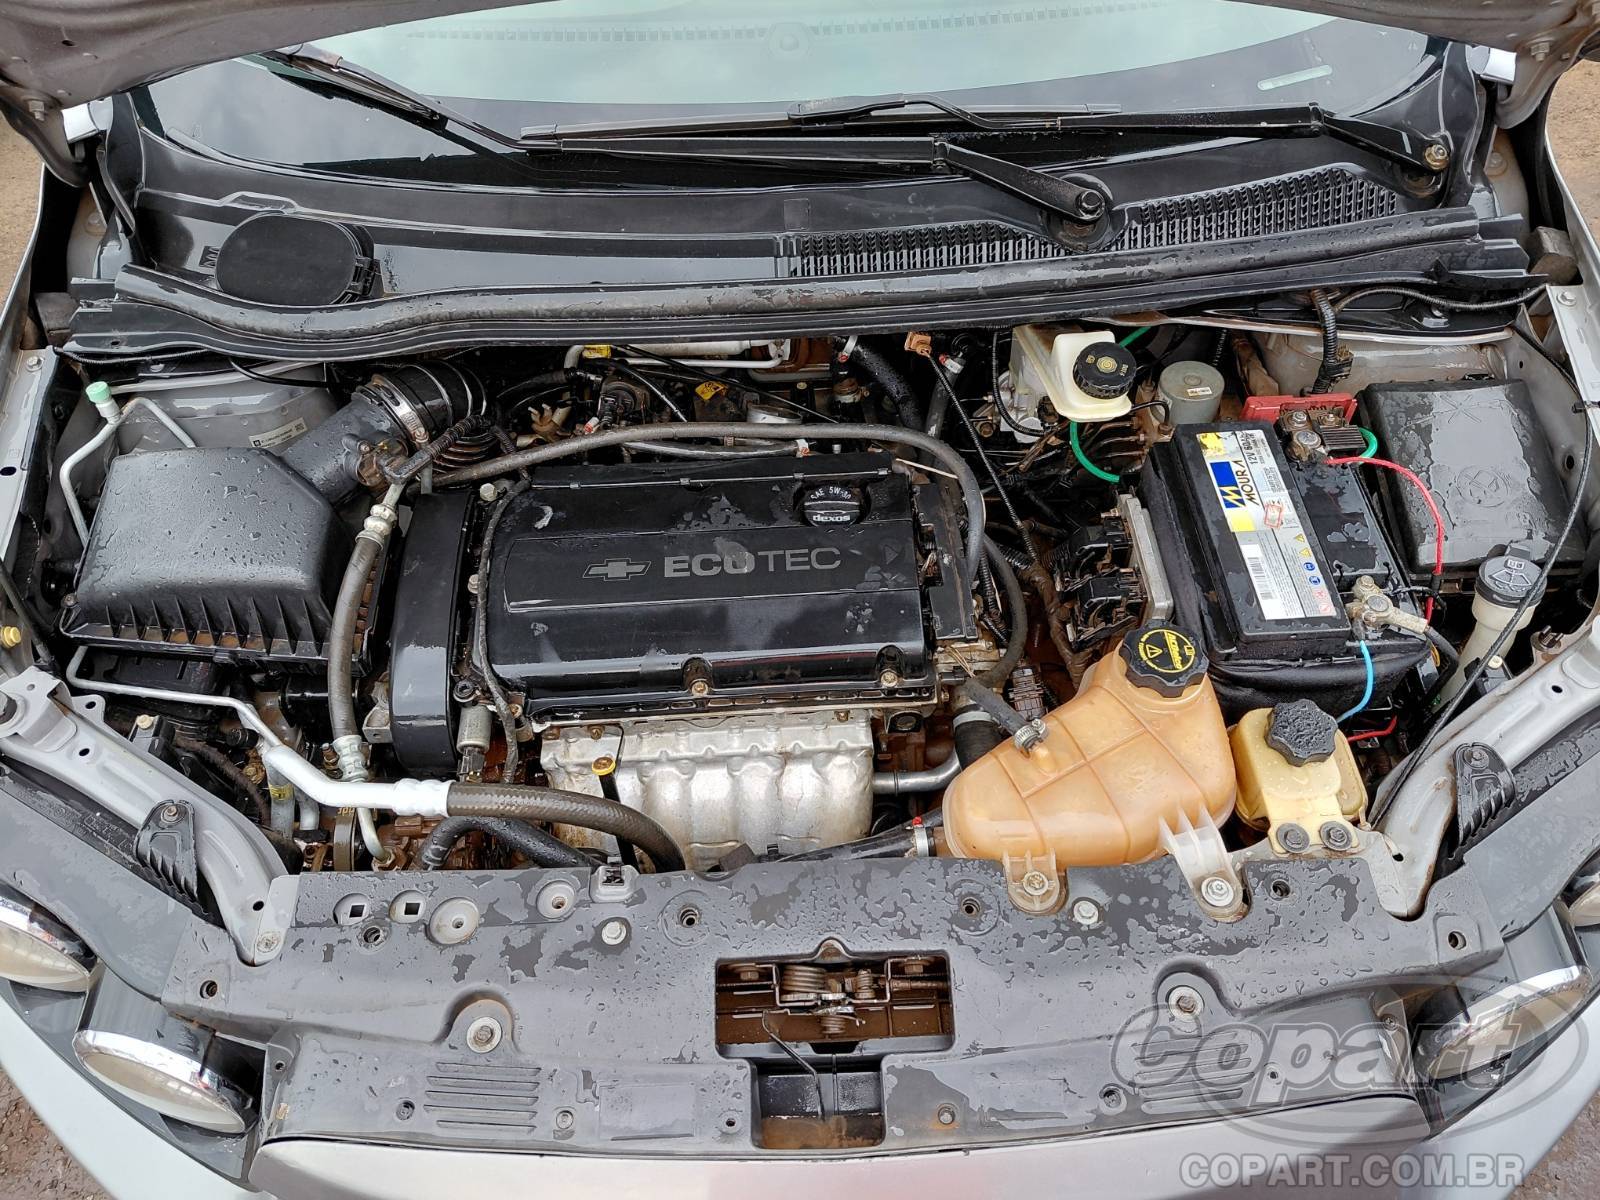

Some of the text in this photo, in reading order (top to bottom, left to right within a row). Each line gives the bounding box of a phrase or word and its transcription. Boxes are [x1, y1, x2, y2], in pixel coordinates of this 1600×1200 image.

[1245, 452, 1259, 465] 12V
[1232, 460, 1260, 506] MOURA
[810, 486, 852, 501] SAE 5W-30
[812, 514, 851, 522] dexos
[664, 547, 842, 578] ECOTEC
